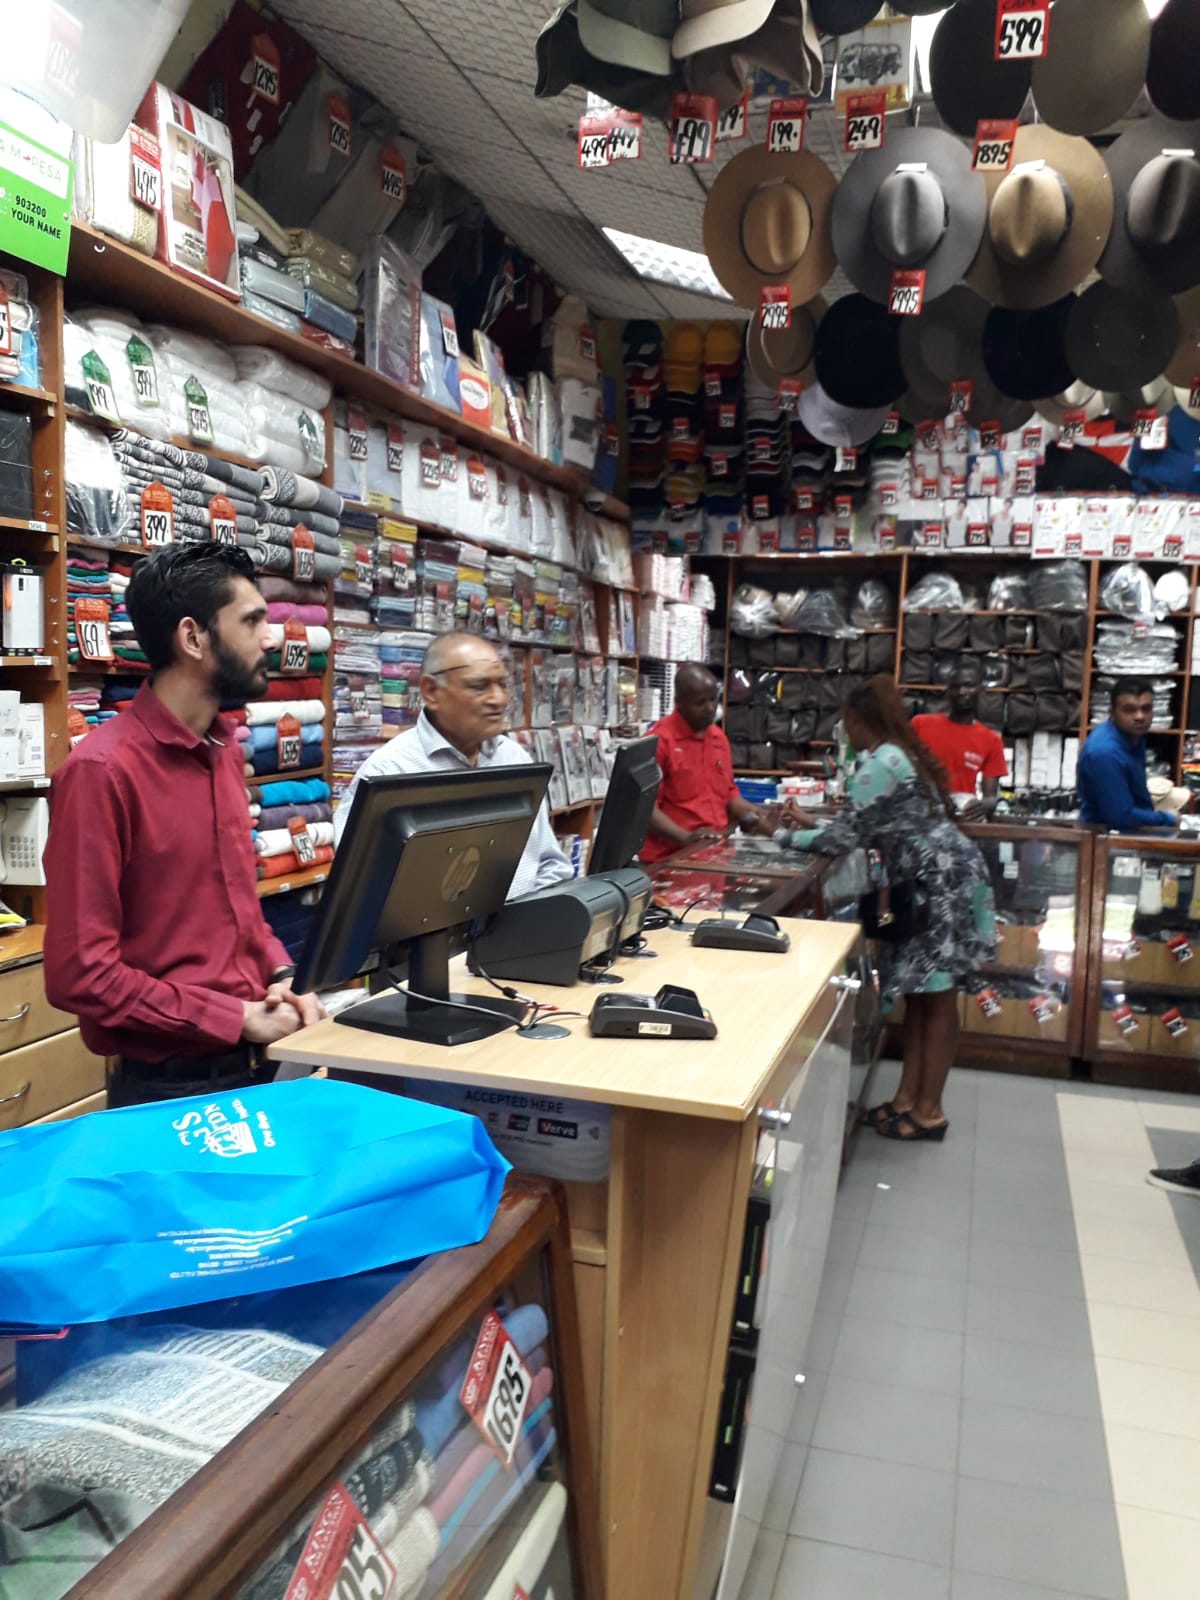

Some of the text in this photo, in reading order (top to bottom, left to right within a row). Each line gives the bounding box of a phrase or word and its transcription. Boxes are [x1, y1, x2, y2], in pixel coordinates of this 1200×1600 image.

[999, 17, 1042, 56] 599
[255, 61, 278, 97] 1295
[848, 117, 880, 142] 249
[582, 138, 607, 159] 499
[974, 147, 1011, 166] 1895
[15, 194, 47, 219] 903200
[11, 207, 62, 240] YOUR NAME
[146, 514, 167, 543] 399
[215, 524, 236, 547] 1295
[81, 623, 98, 658] 169
[285, 645, 306, 668] 1595
[465, 1090, 564, 1114] ACCEPTED HERE
[542, 1119, 576, 1136] Verve
[486, 1354, 524, 1456] 1695
